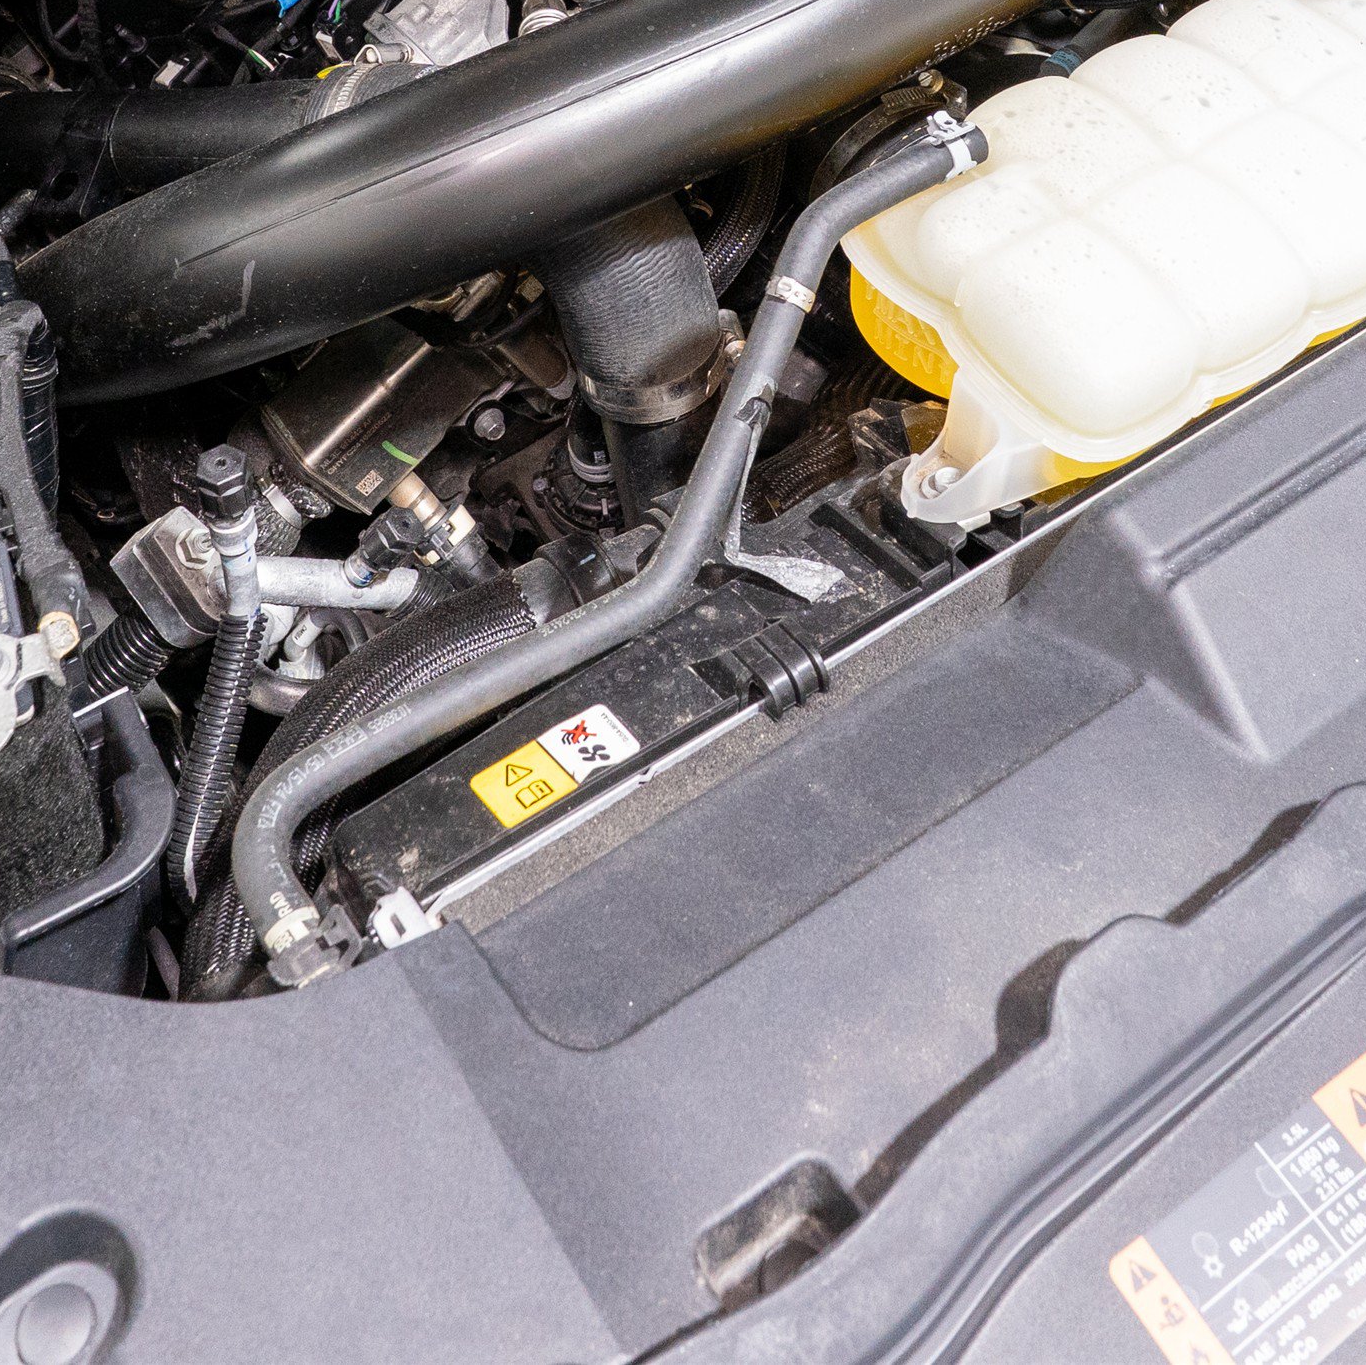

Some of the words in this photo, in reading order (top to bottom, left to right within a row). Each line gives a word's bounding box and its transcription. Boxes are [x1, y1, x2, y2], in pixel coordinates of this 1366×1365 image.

[270, 891, 293, 918] RAD
[1317, 1136, 1339, 1154] kg
[1230, 1201, 1287, 1255] R-1234yf
[1285, 1234, 1318, 1266] PAG
